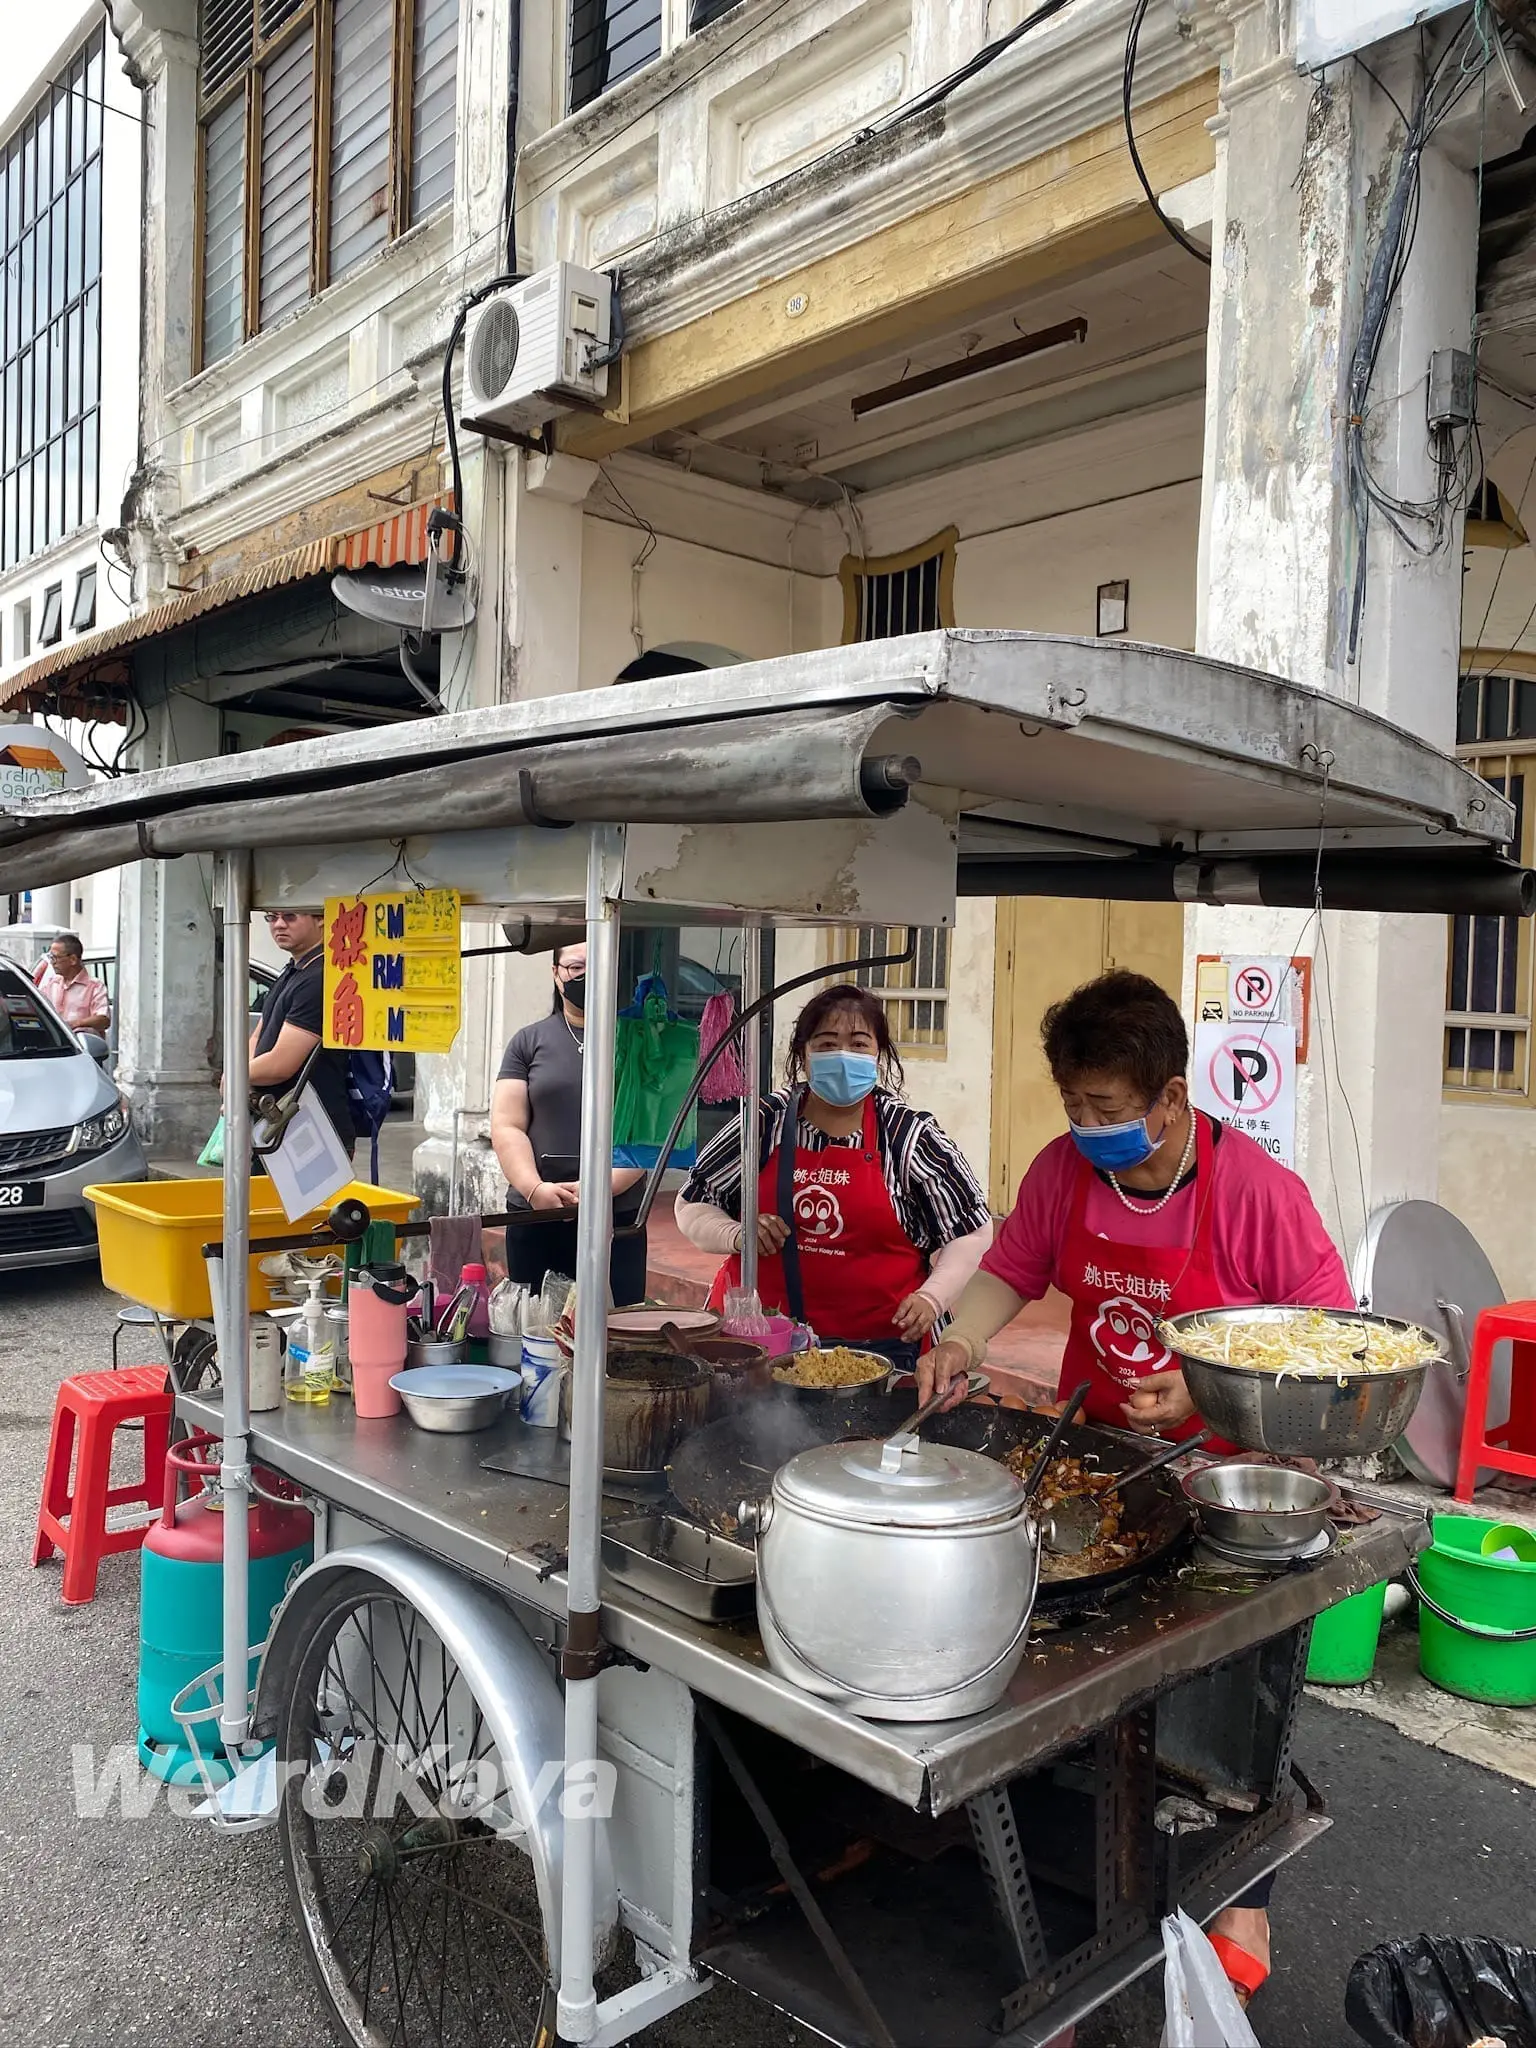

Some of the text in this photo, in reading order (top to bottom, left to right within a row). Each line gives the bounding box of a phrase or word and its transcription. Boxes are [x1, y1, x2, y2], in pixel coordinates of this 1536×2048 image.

[790, 296, 802, 312] 98
[370, 584, 426, 600] astro
[6, 769, 40, 784] rain
[373, 953, 404, 989] RM
[1244, 1010, 1275, 1018] PARKING
[0, 1186, 23, 1206] 28
[1082, 1261, 1172, 1302] 姚氏姐妹
[1118, 1366, 1137, 1377] 2024
